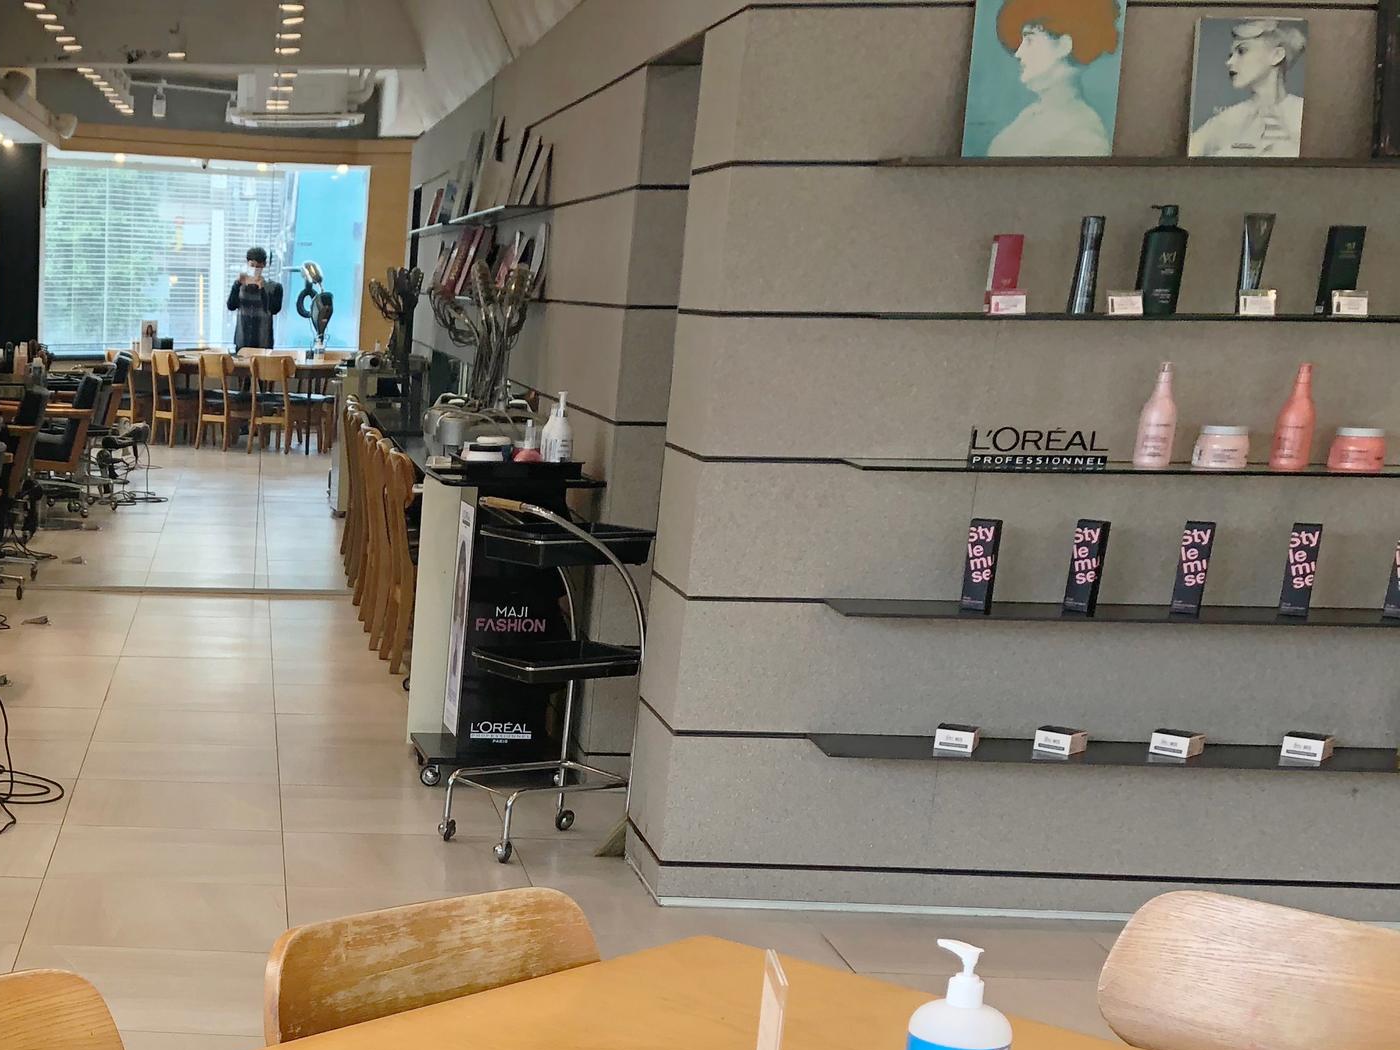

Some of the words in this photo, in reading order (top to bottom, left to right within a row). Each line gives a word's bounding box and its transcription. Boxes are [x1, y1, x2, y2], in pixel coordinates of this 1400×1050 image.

[972, 426, 1109, 452] L'ORÉAL
[972, 456, 1106, 465] PROFESSIONNEL
[495, 606, 528, 618] MAJI
[475, 618, 546, 632] FASHION
[470, 721, 531, 733] L'ORÉAL
